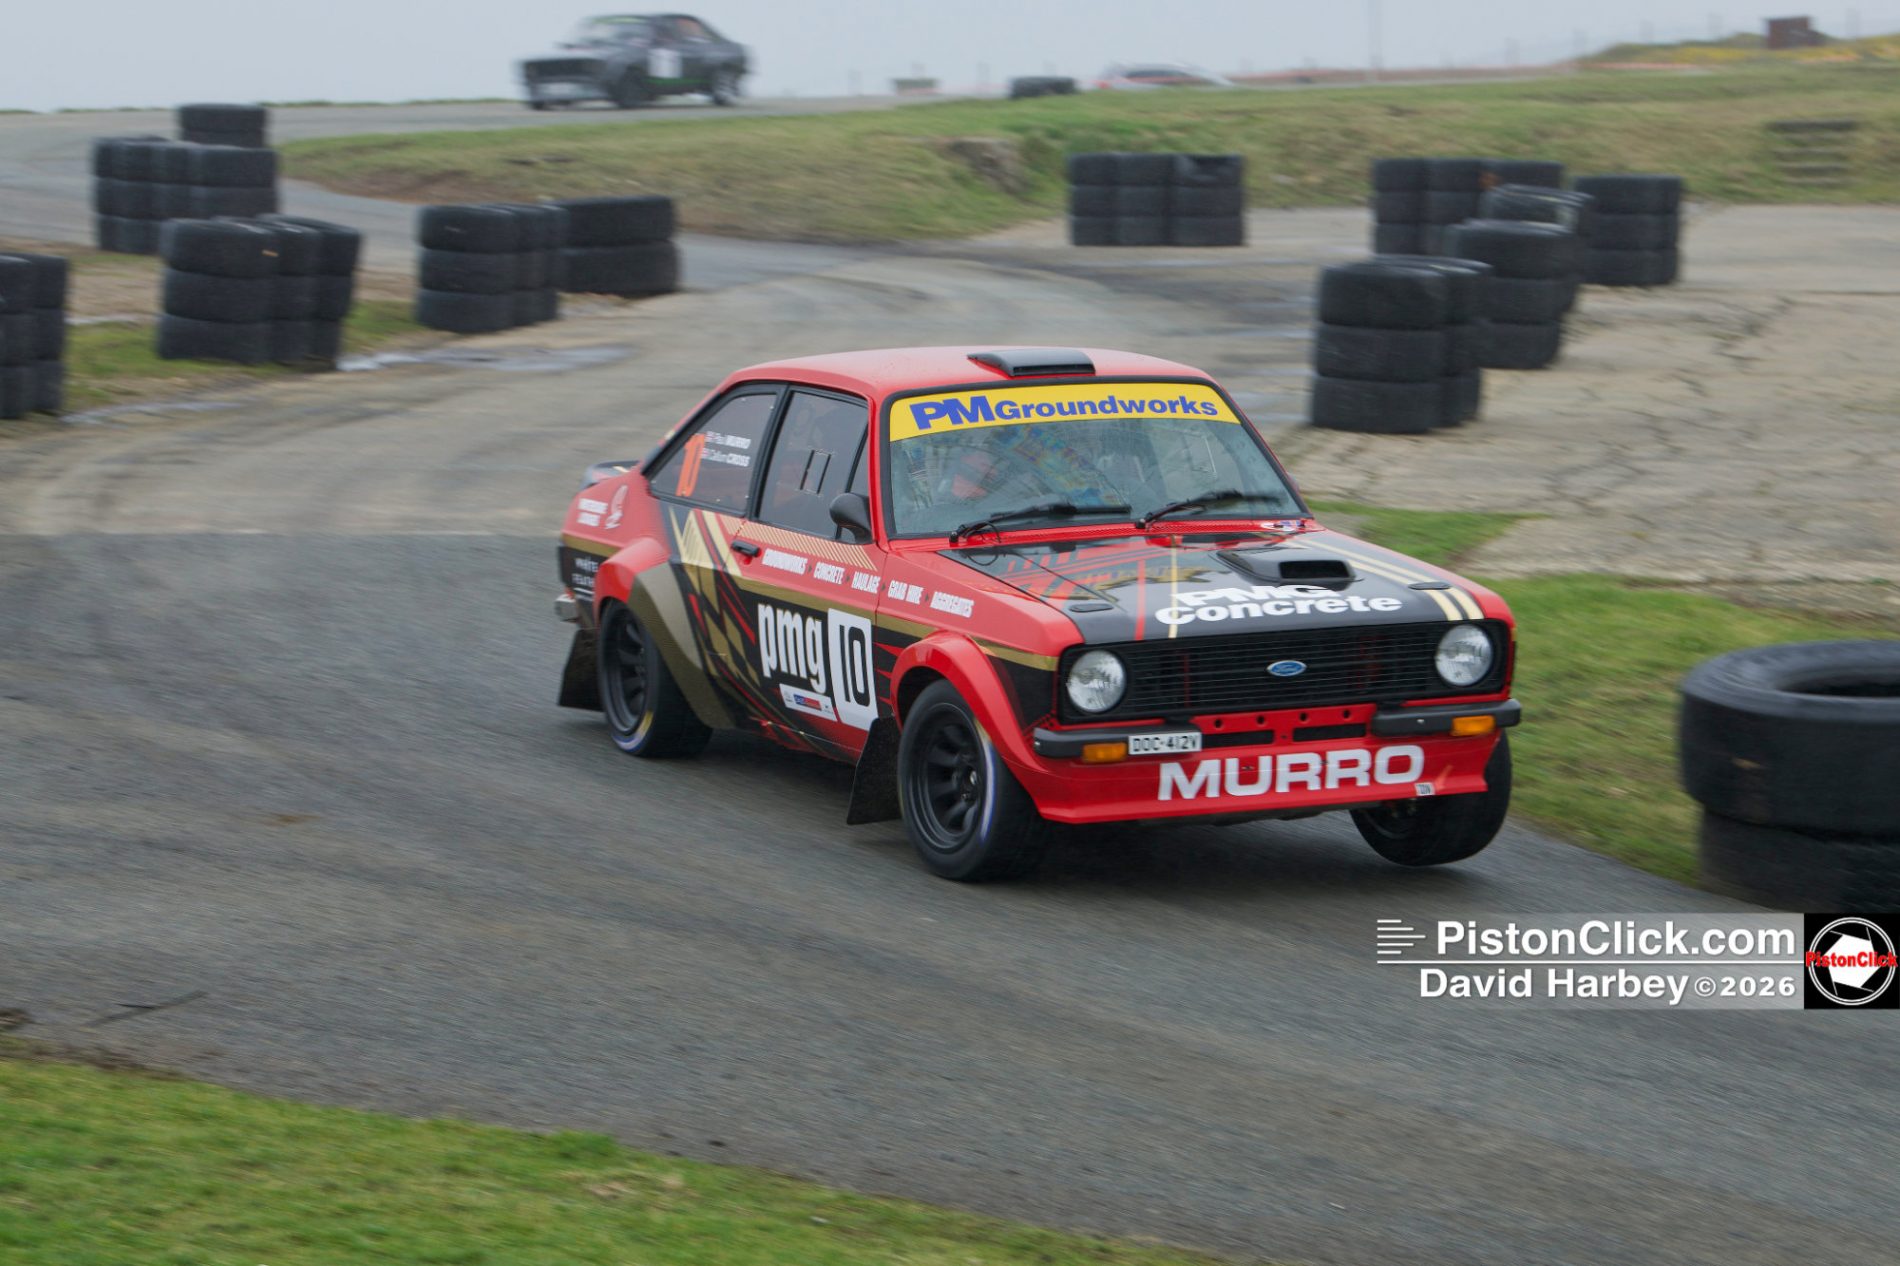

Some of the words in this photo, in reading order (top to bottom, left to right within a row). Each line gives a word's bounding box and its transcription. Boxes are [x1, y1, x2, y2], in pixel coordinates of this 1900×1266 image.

[1169, 585, 1341, 606] PMG
[757, 603, 827, 694] pmg
[839, 624, 871, 707] 10
[1157, 745, 1425, 800] MURRO
